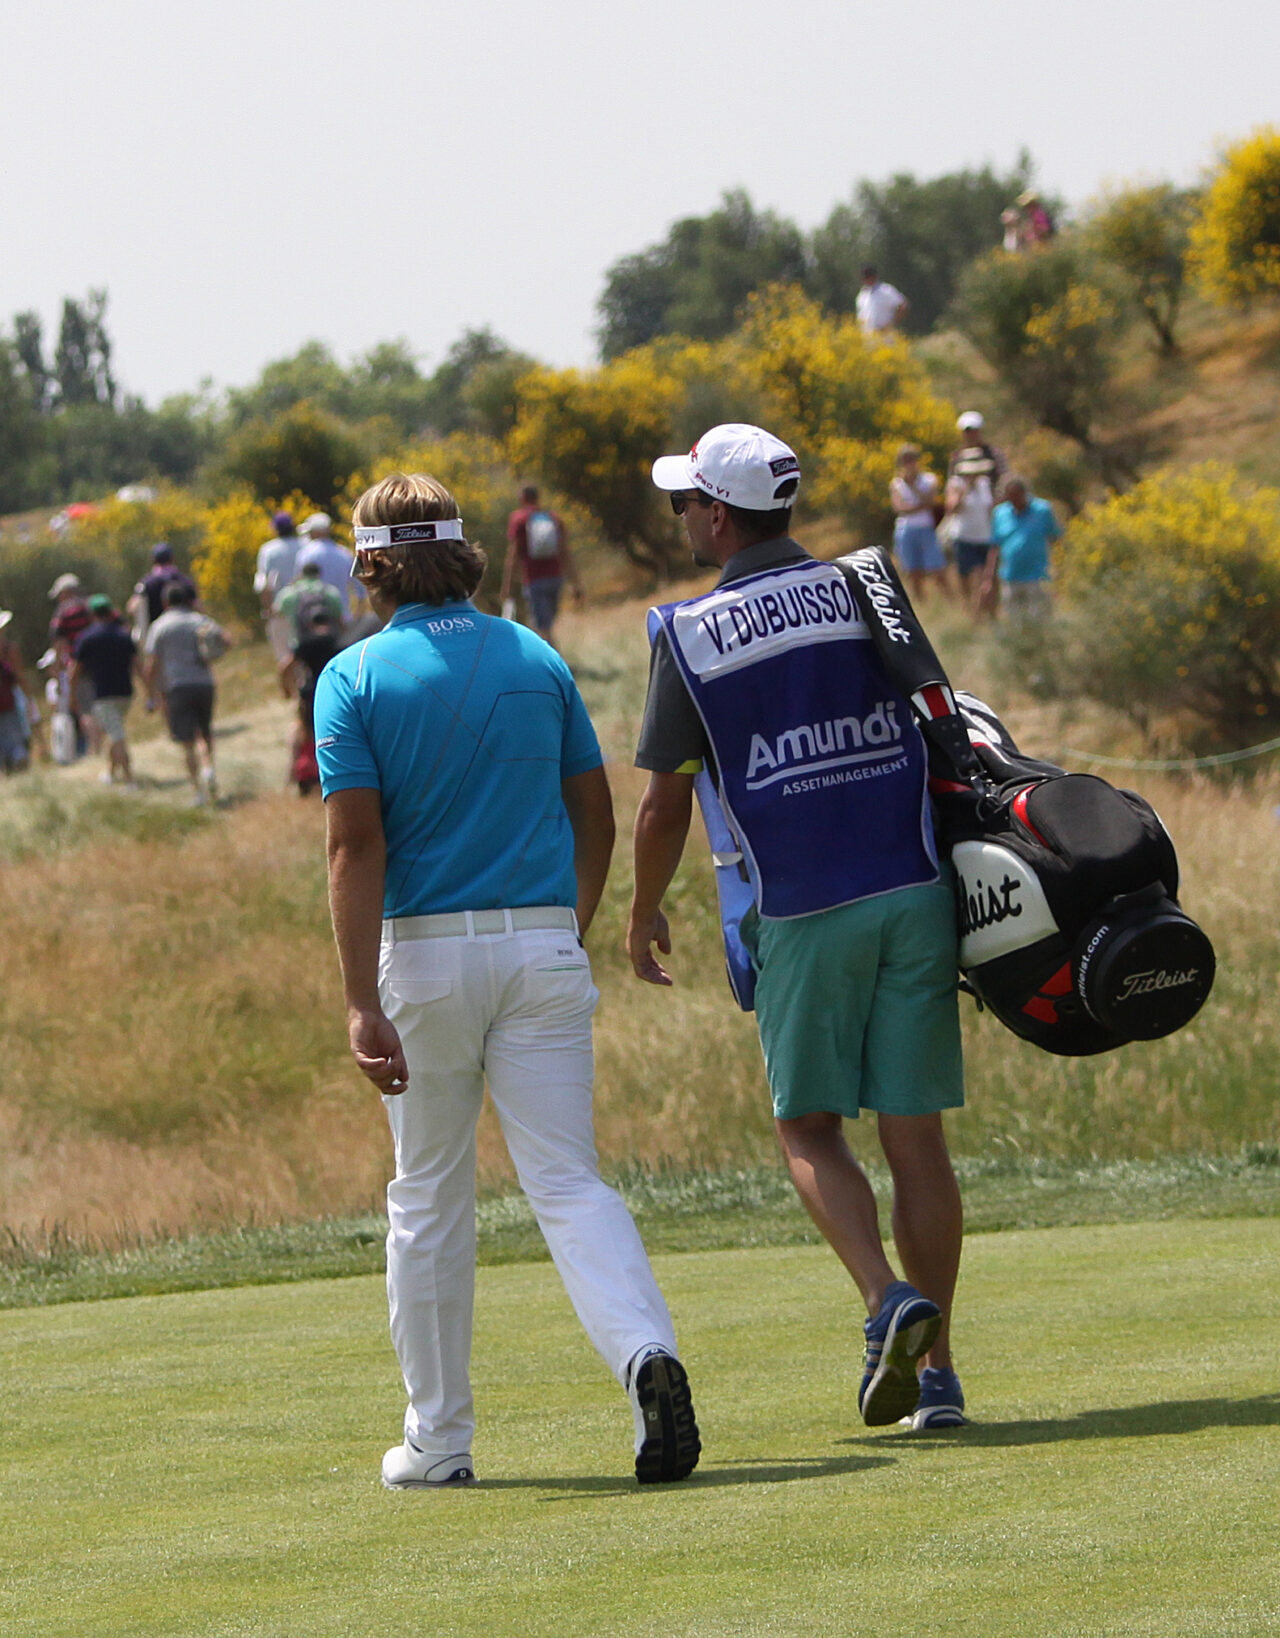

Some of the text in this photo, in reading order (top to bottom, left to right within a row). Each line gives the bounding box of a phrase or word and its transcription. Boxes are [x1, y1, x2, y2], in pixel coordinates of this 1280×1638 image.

[716, 485, 731, 499] V1
[847, 549, 910, 645] Titleist
[426, 616, 475, 633] BOSS
[701, 612, 733, 656] V.
[745, 700, 902, 779] Amundi
[1116, 967, 1199, 1000] Titleist
